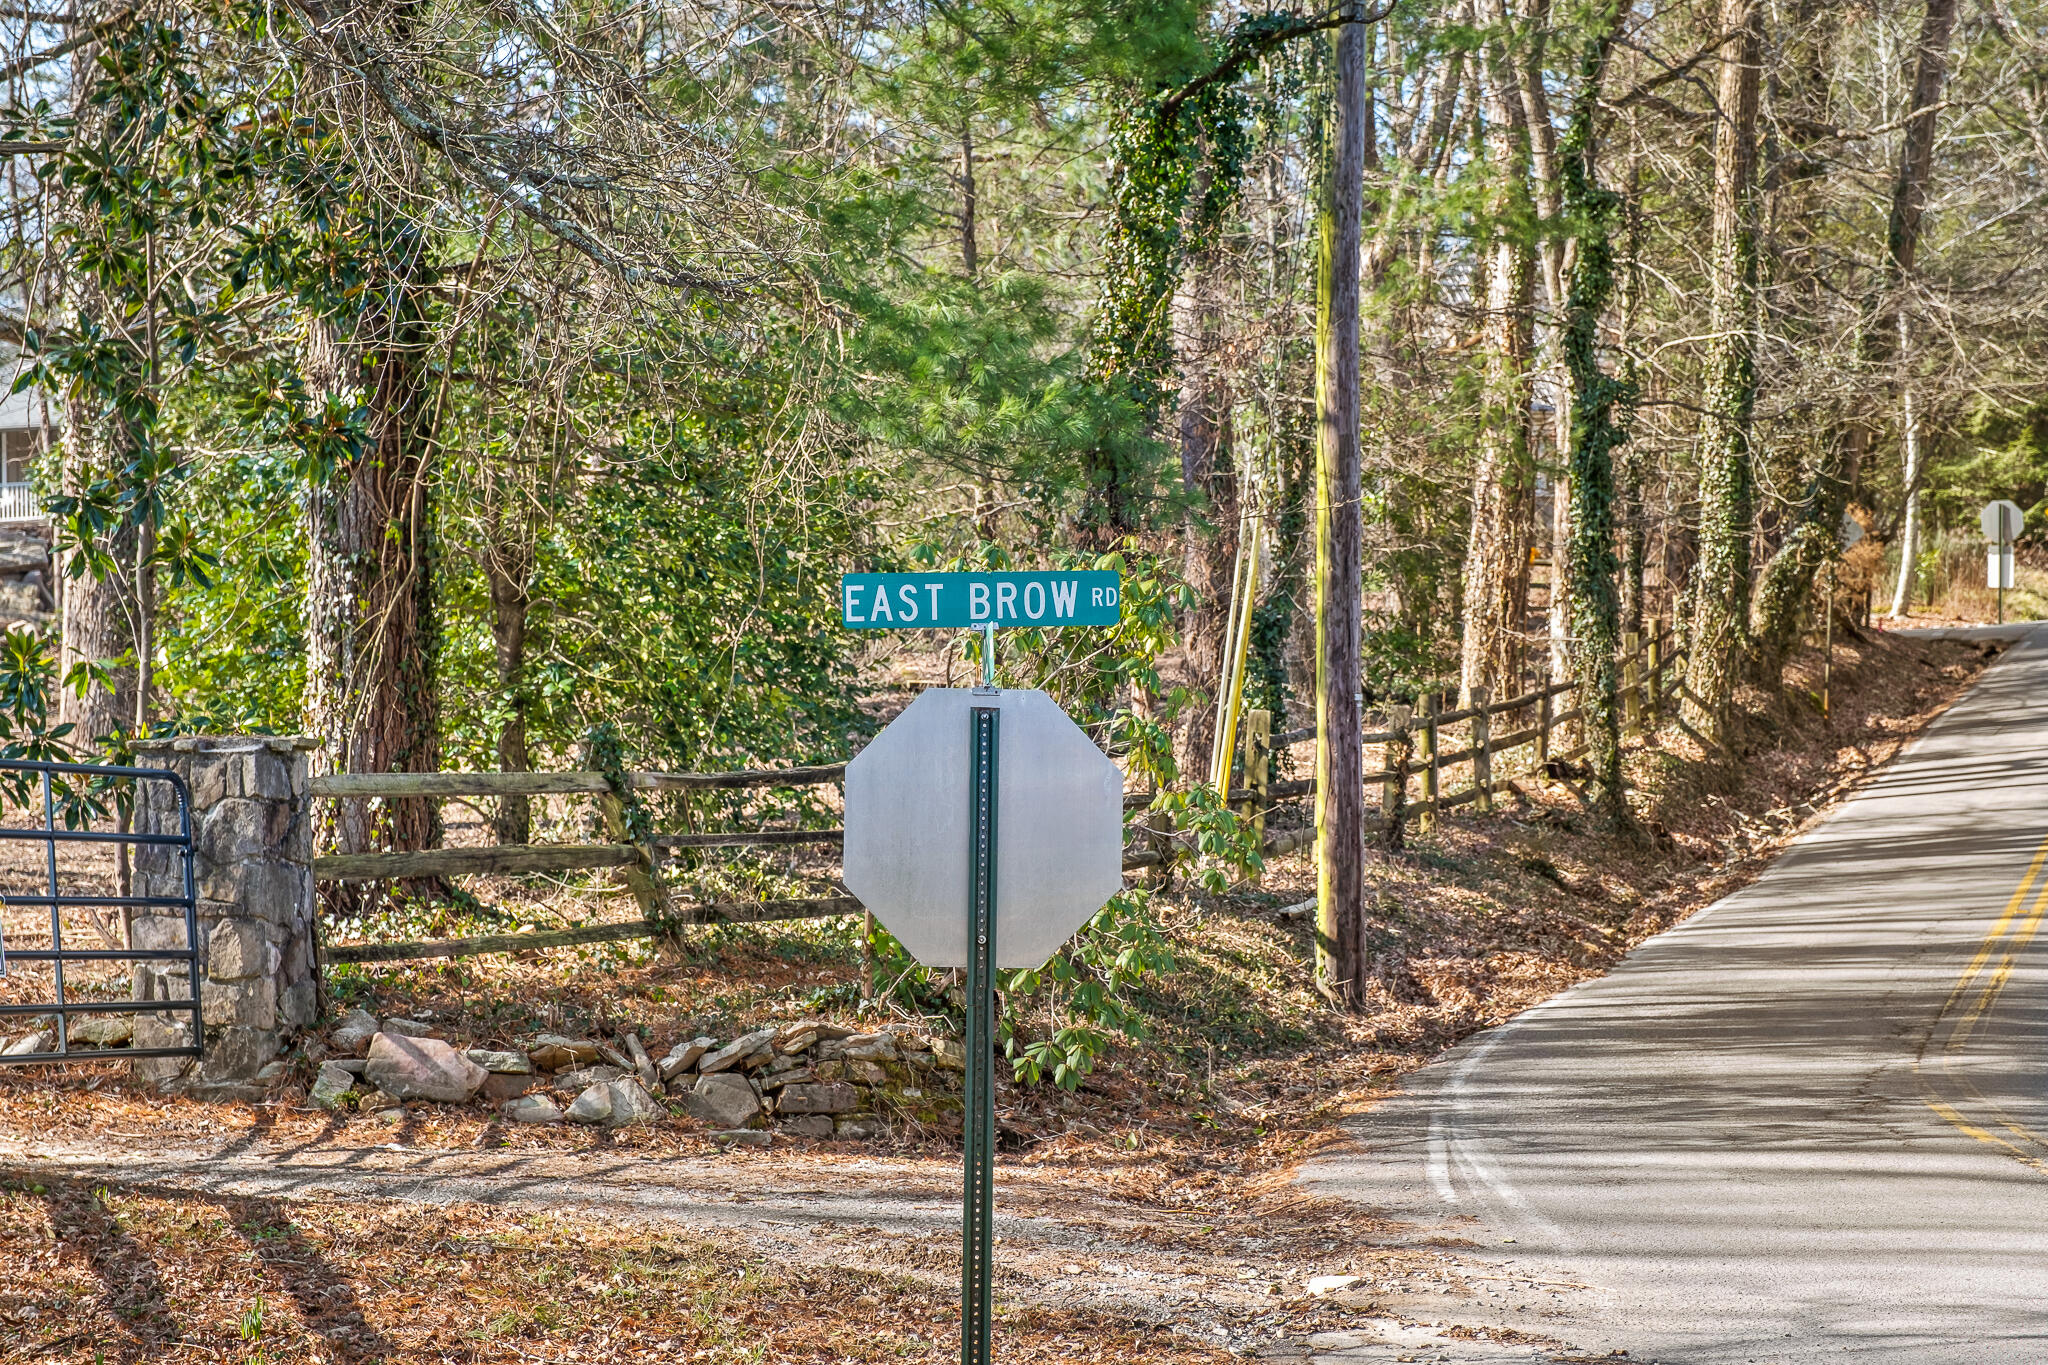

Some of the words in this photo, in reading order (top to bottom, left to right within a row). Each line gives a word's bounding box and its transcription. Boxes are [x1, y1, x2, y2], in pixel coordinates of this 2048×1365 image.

[845, 584, 943, 622] EAST
[969, 581, 1078, 620] BROW
[1091, 587, 1118, 607] RD
